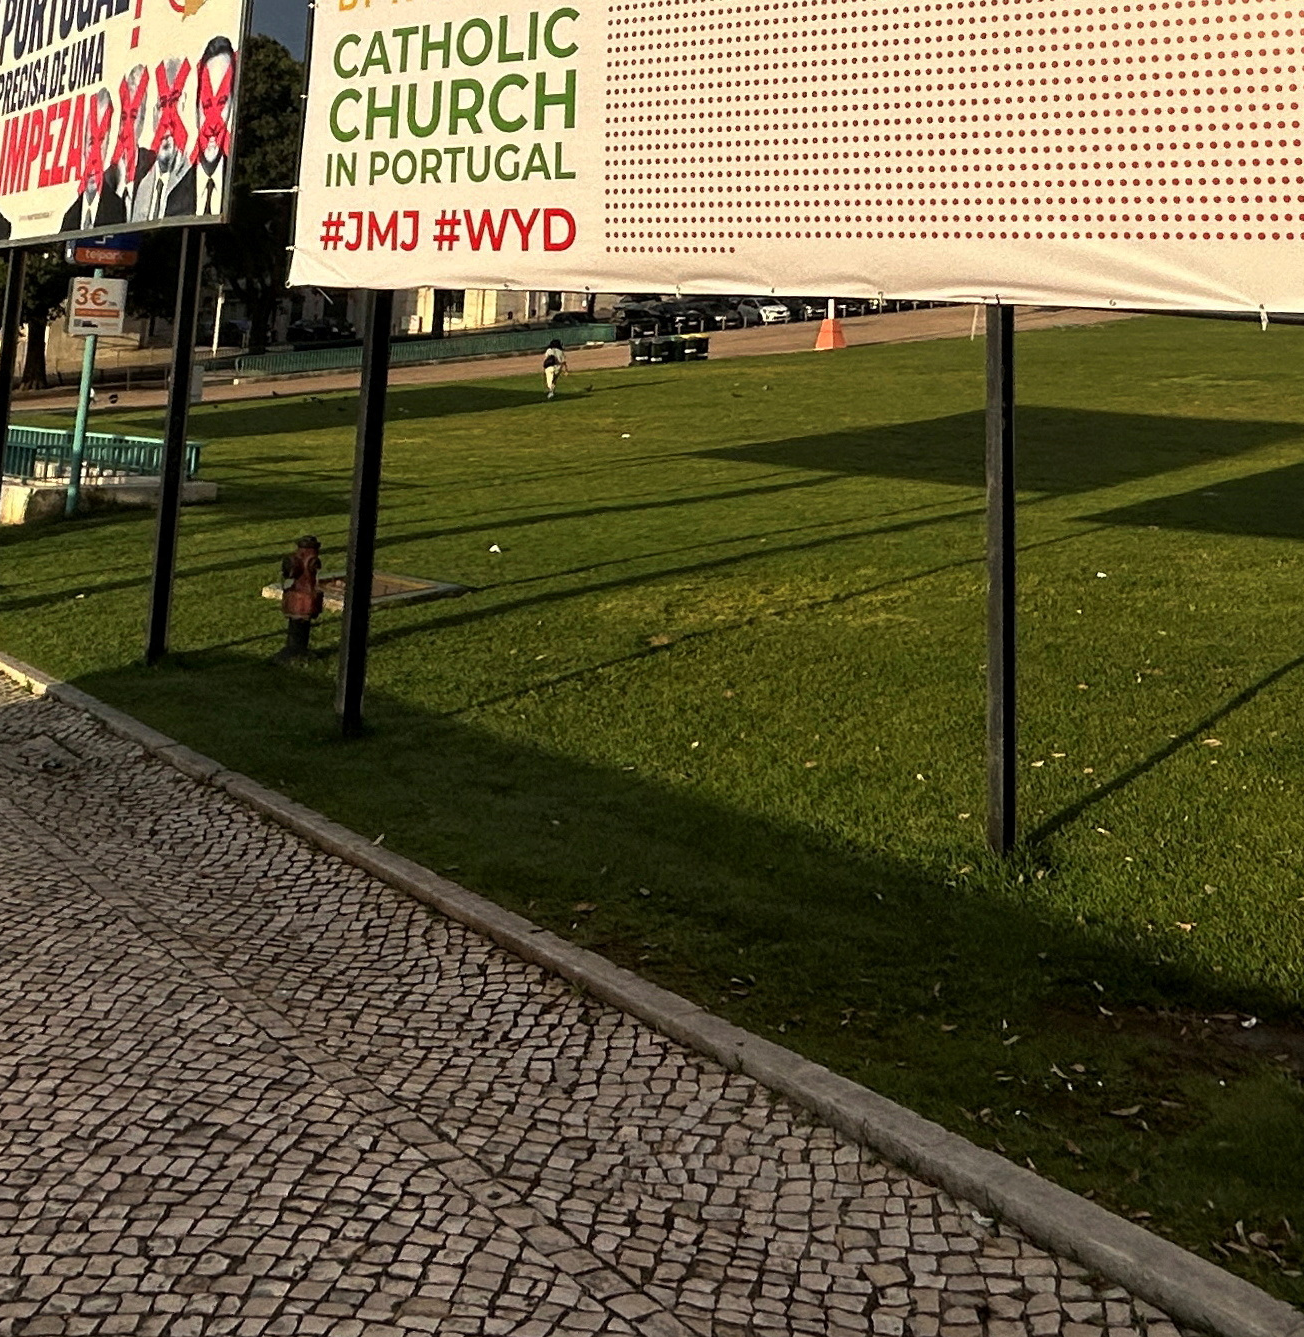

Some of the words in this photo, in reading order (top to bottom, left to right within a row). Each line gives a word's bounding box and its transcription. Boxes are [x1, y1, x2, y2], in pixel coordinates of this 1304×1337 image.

[48, 48, 68, 100] DE
[67, 31, 106, 93] UMA
[333, 7, 580, 79] CATHOLIC
[329, 69, 577, 142] CHURCH
[325, 152, 357, 187] IN
[369, 142, 576, 185] PORTUGAL
[320, 210, 420, 251] #JMJ
[433, 208, 576, 251] #WYD
[75, 286, 109, 306] 3€
